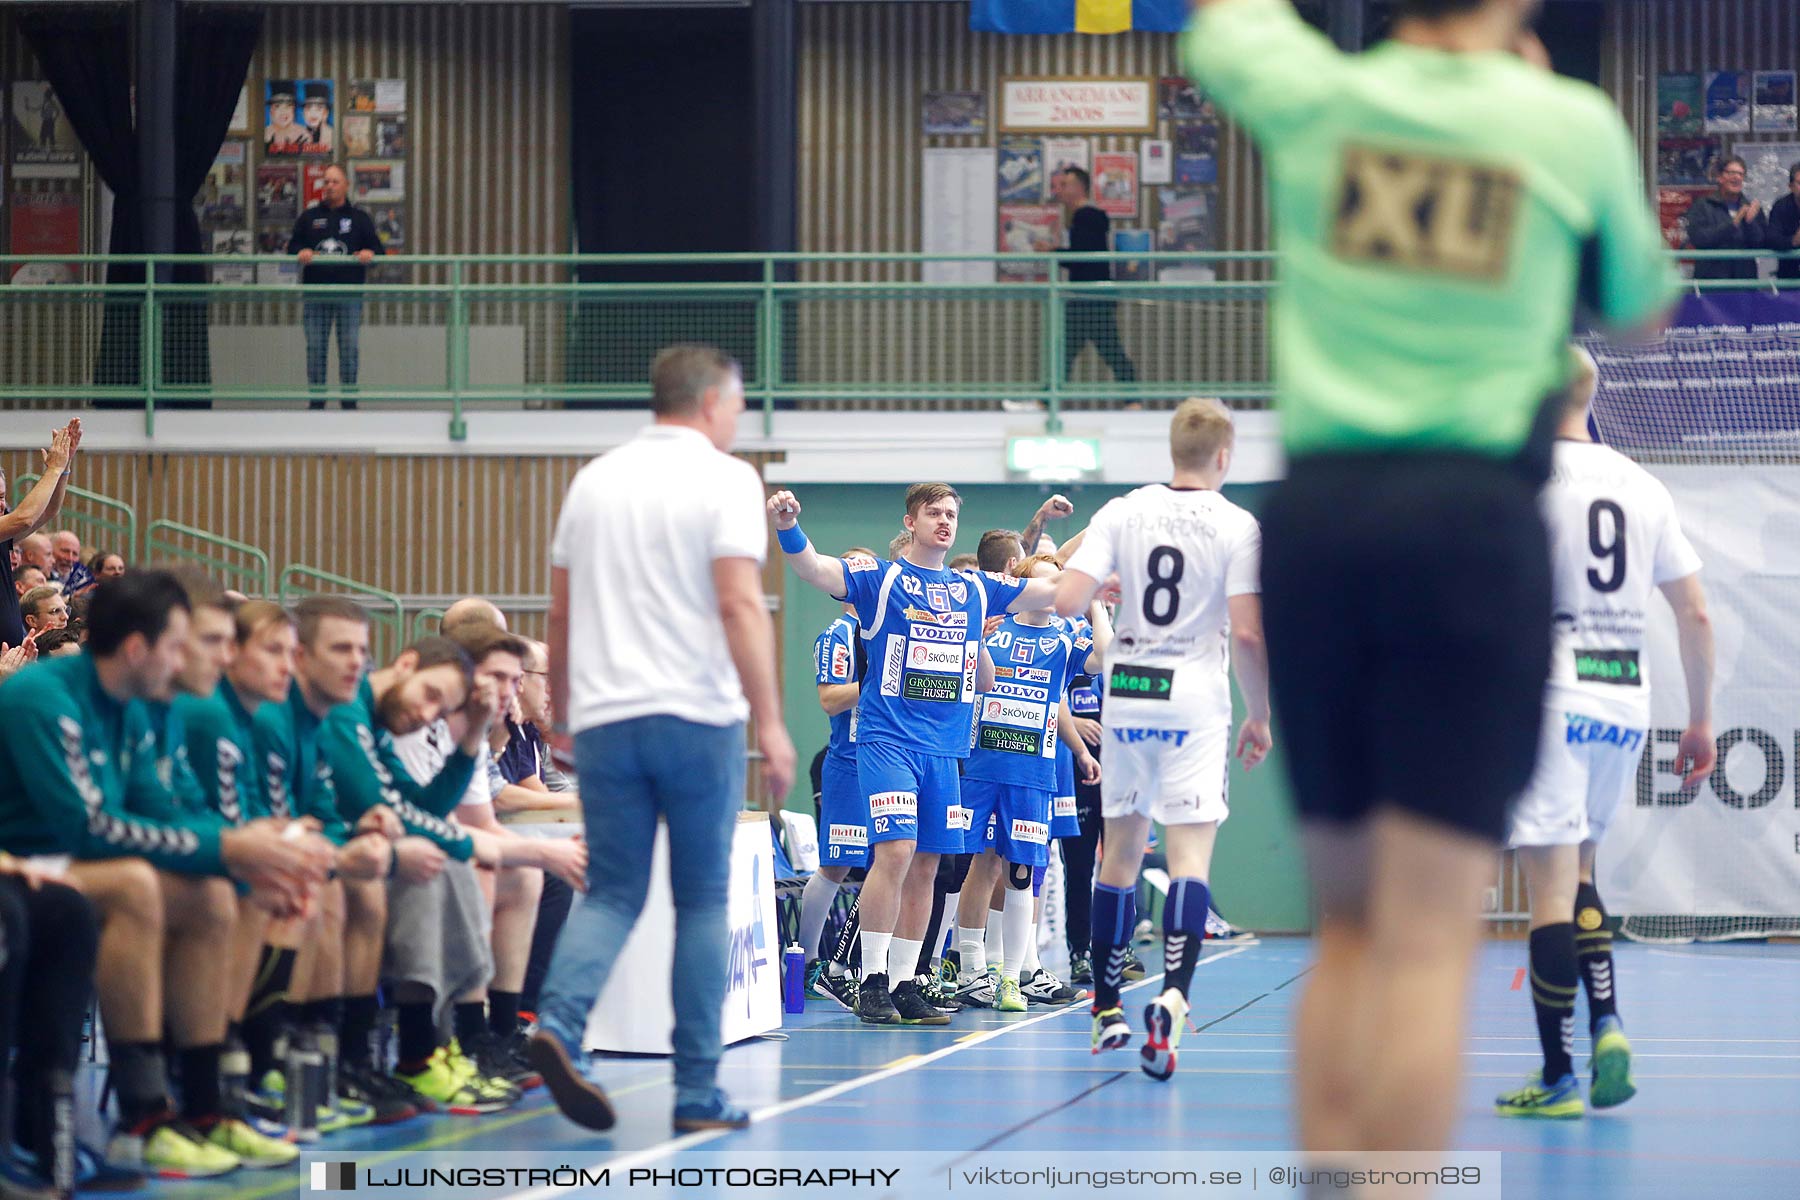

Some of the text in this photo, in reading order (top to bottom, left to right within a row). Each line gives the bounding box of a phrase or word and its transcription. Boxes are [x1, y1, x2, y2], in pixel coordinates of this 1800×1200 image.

[1586, 499, 1627, 594] 9
[901, 574, 924, 597] 62
[1142, 545, 1184, 626] 8
[913, 626, 965, 641] VOLVO
[986, 631, 1012, 648] 20
[928, 652, 960, 664] SKÖVDE
[909, 677, 957, 690] GRÖNSAKS
[922, 688, 950, 699] HUSET
[991, 684, 1046, 699] VOLVO
[1002, 707, 1041, 721] SKÖVDE
[984, 728, 1036, 744] GRÖNSAKS
[996, 739, 1028, 752] HUSET
[1636, 727, 1800, 809] BO
[875, 817, 889, 833] 62
[986, 826, 994, 840] 8
[829, 845, 841, 859] 10
